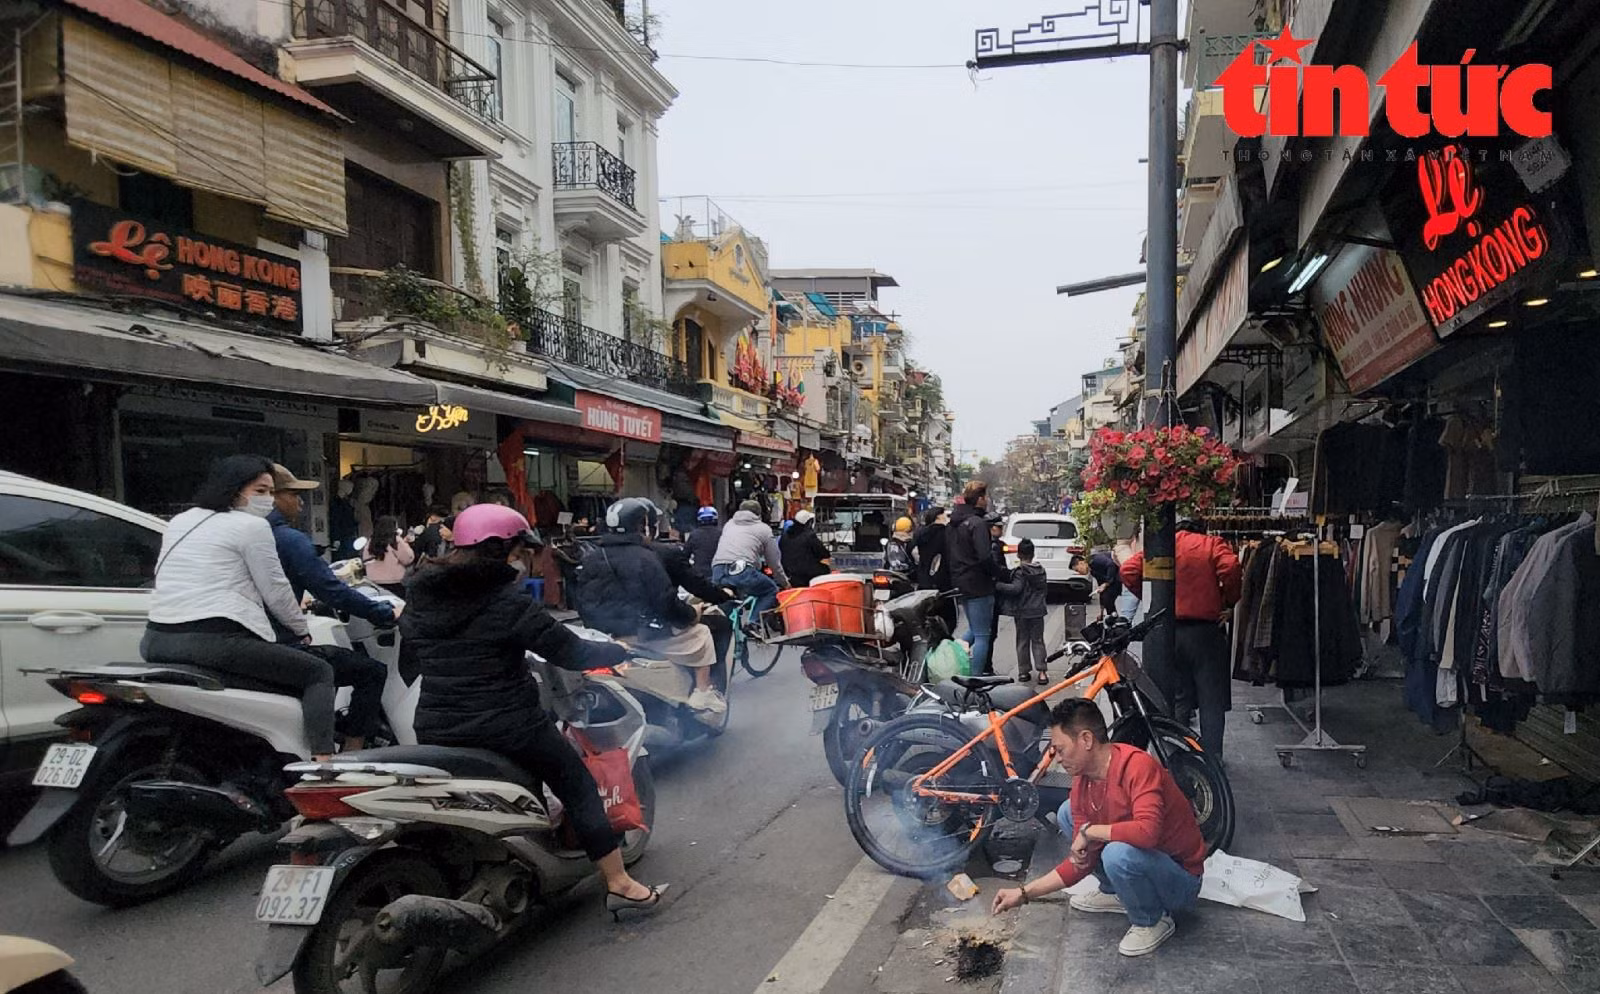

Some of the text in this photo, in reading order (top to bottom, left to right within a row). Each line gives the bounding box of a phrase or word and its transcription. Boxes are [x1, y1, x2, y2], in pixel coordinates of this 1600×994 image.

[90, 220, 300, 291] Lệ HONG KONG
[37, 767, 83, 785] 026.06
[271, 869, 323, 894] 29-F1
[258, 895, 322, 920] 092.37
